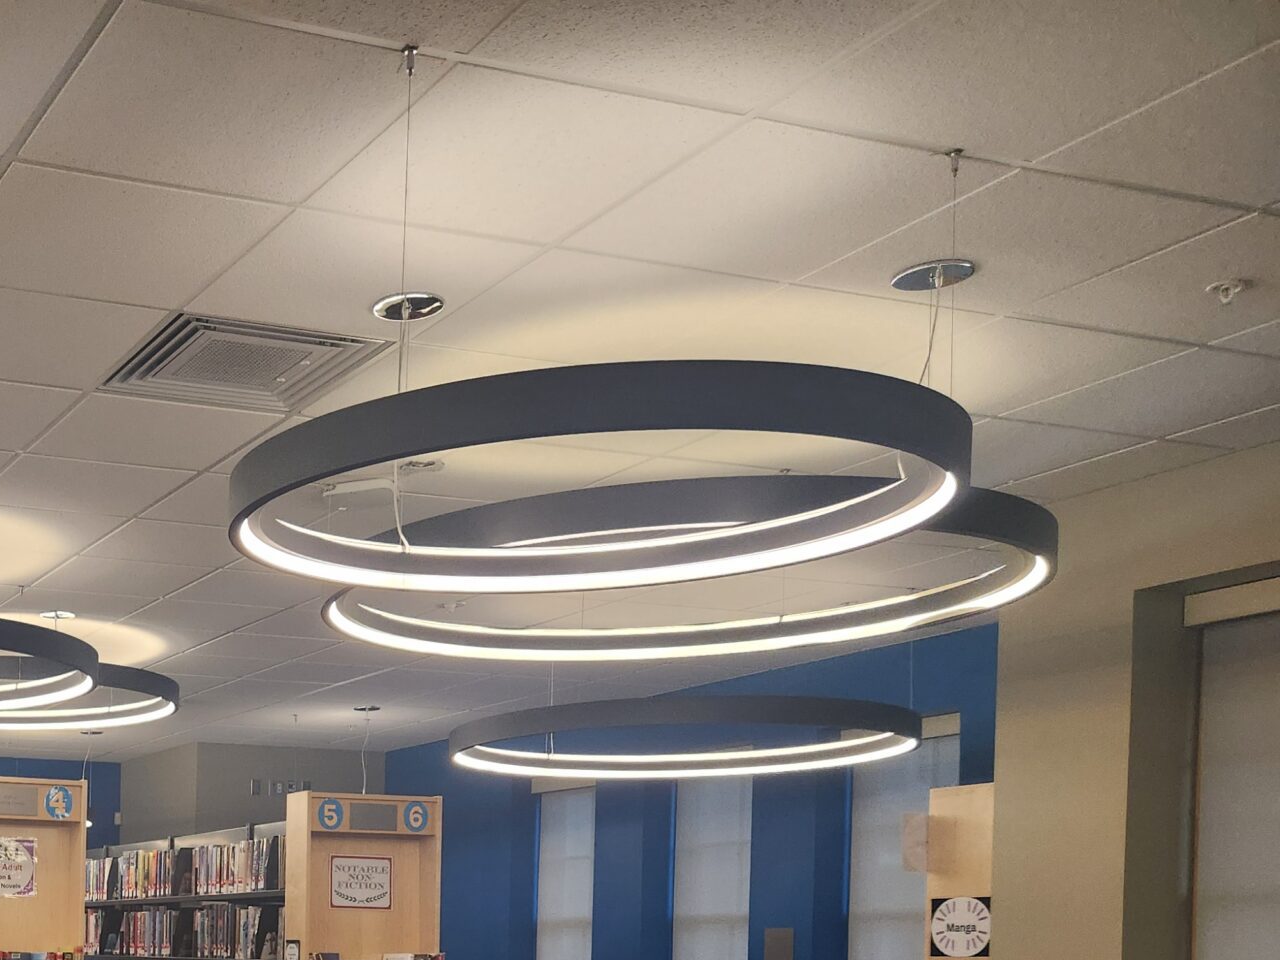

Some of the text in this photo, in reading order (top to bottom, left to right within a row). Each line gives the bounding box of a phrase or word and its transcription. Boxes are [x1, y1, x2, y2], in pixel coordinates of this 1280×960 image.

[48, 790, 66, 815] 4
[323, 804, 338, 827] 5
[409, 805, 423, 828] 6
[2, 863, 23, 872] Adult
[334, 864, 389, 875] NOTABLE
[337, 881, 385, 890] FICTION
[946, 923, 977, 934] Manga
